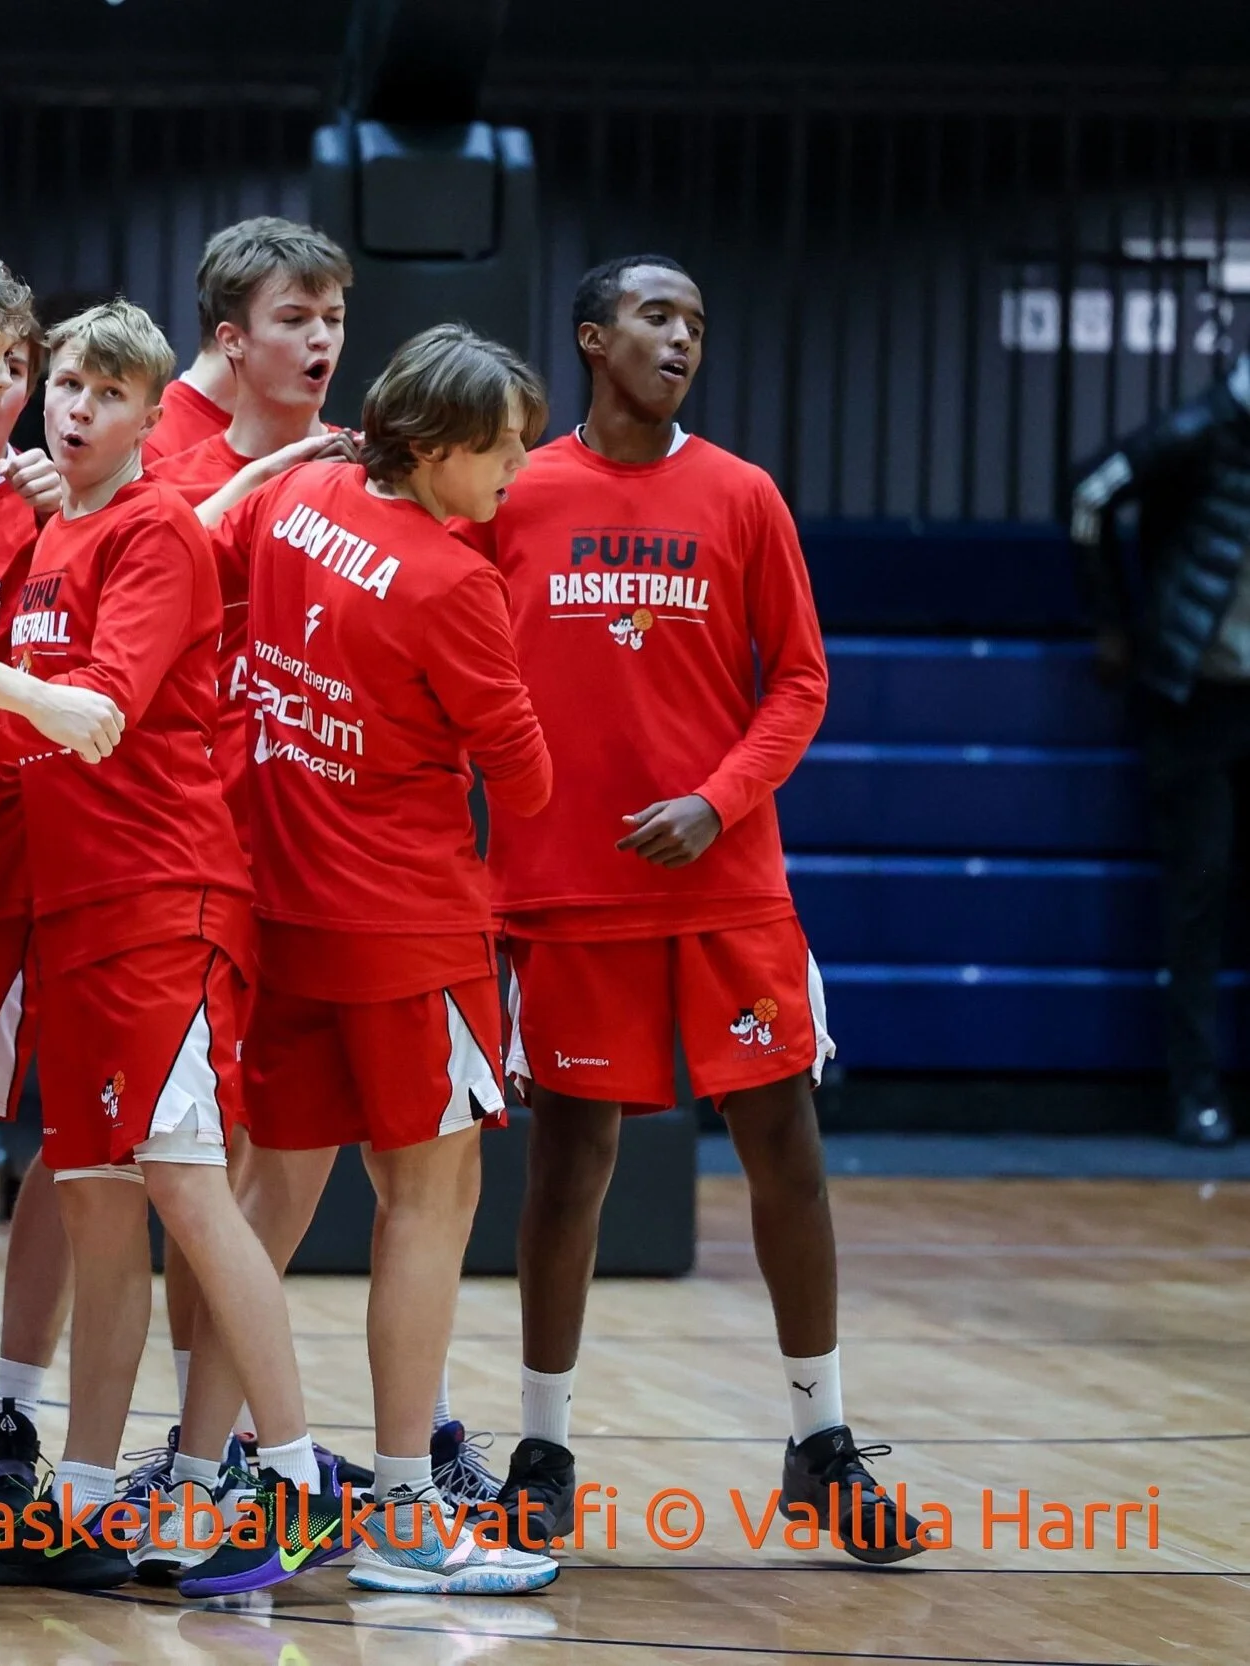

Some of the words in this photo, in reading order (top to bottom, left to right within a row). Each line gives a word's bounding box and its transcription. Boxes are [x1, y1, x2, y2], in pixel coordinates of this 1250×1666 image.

[571, 535, 698, 570] PUHU
[549, 571, 710, 612] BASKETBALL
[302, 661, 353, 704] Energia
